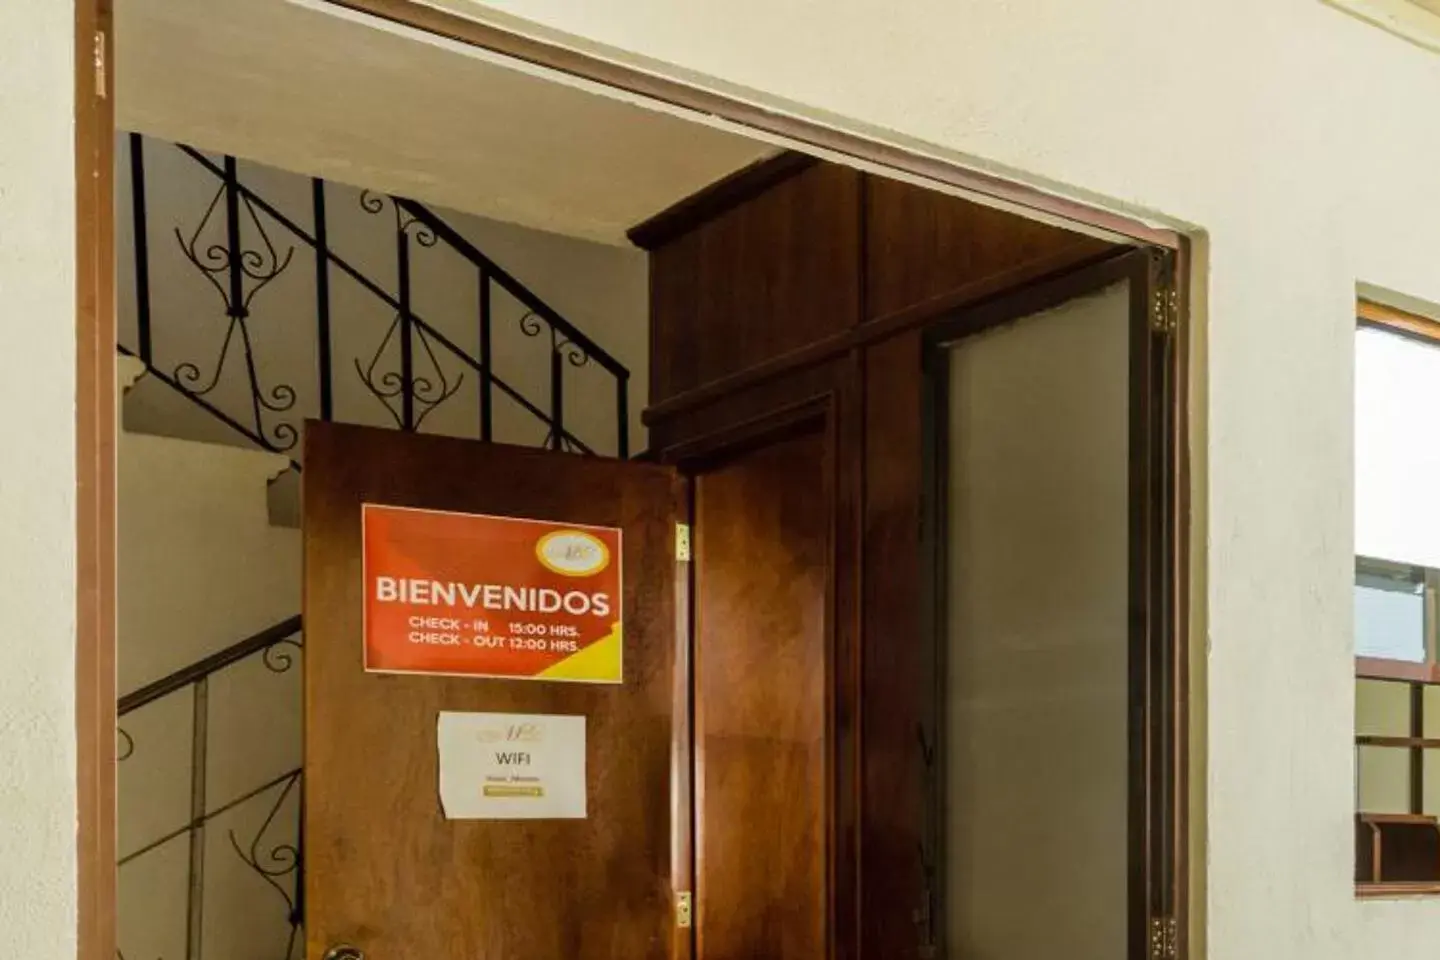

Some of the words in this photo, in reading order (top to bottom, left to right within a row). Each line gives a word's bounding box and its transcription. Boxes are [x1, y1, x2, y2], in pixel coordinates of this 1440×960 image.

[376, 576, 610, 617] BIENVENIDOS
[408, 616, 461, 632] CHECK
[473, 621, 489, 633] IN
[509, 622, 546, 636] 15:00
[408, 632, 461, 646] CHECK
[473, 635, 505, 648] OUT
[508, 637, 546, 651] 12:00
[495, 752, 531, 765] WIFI
